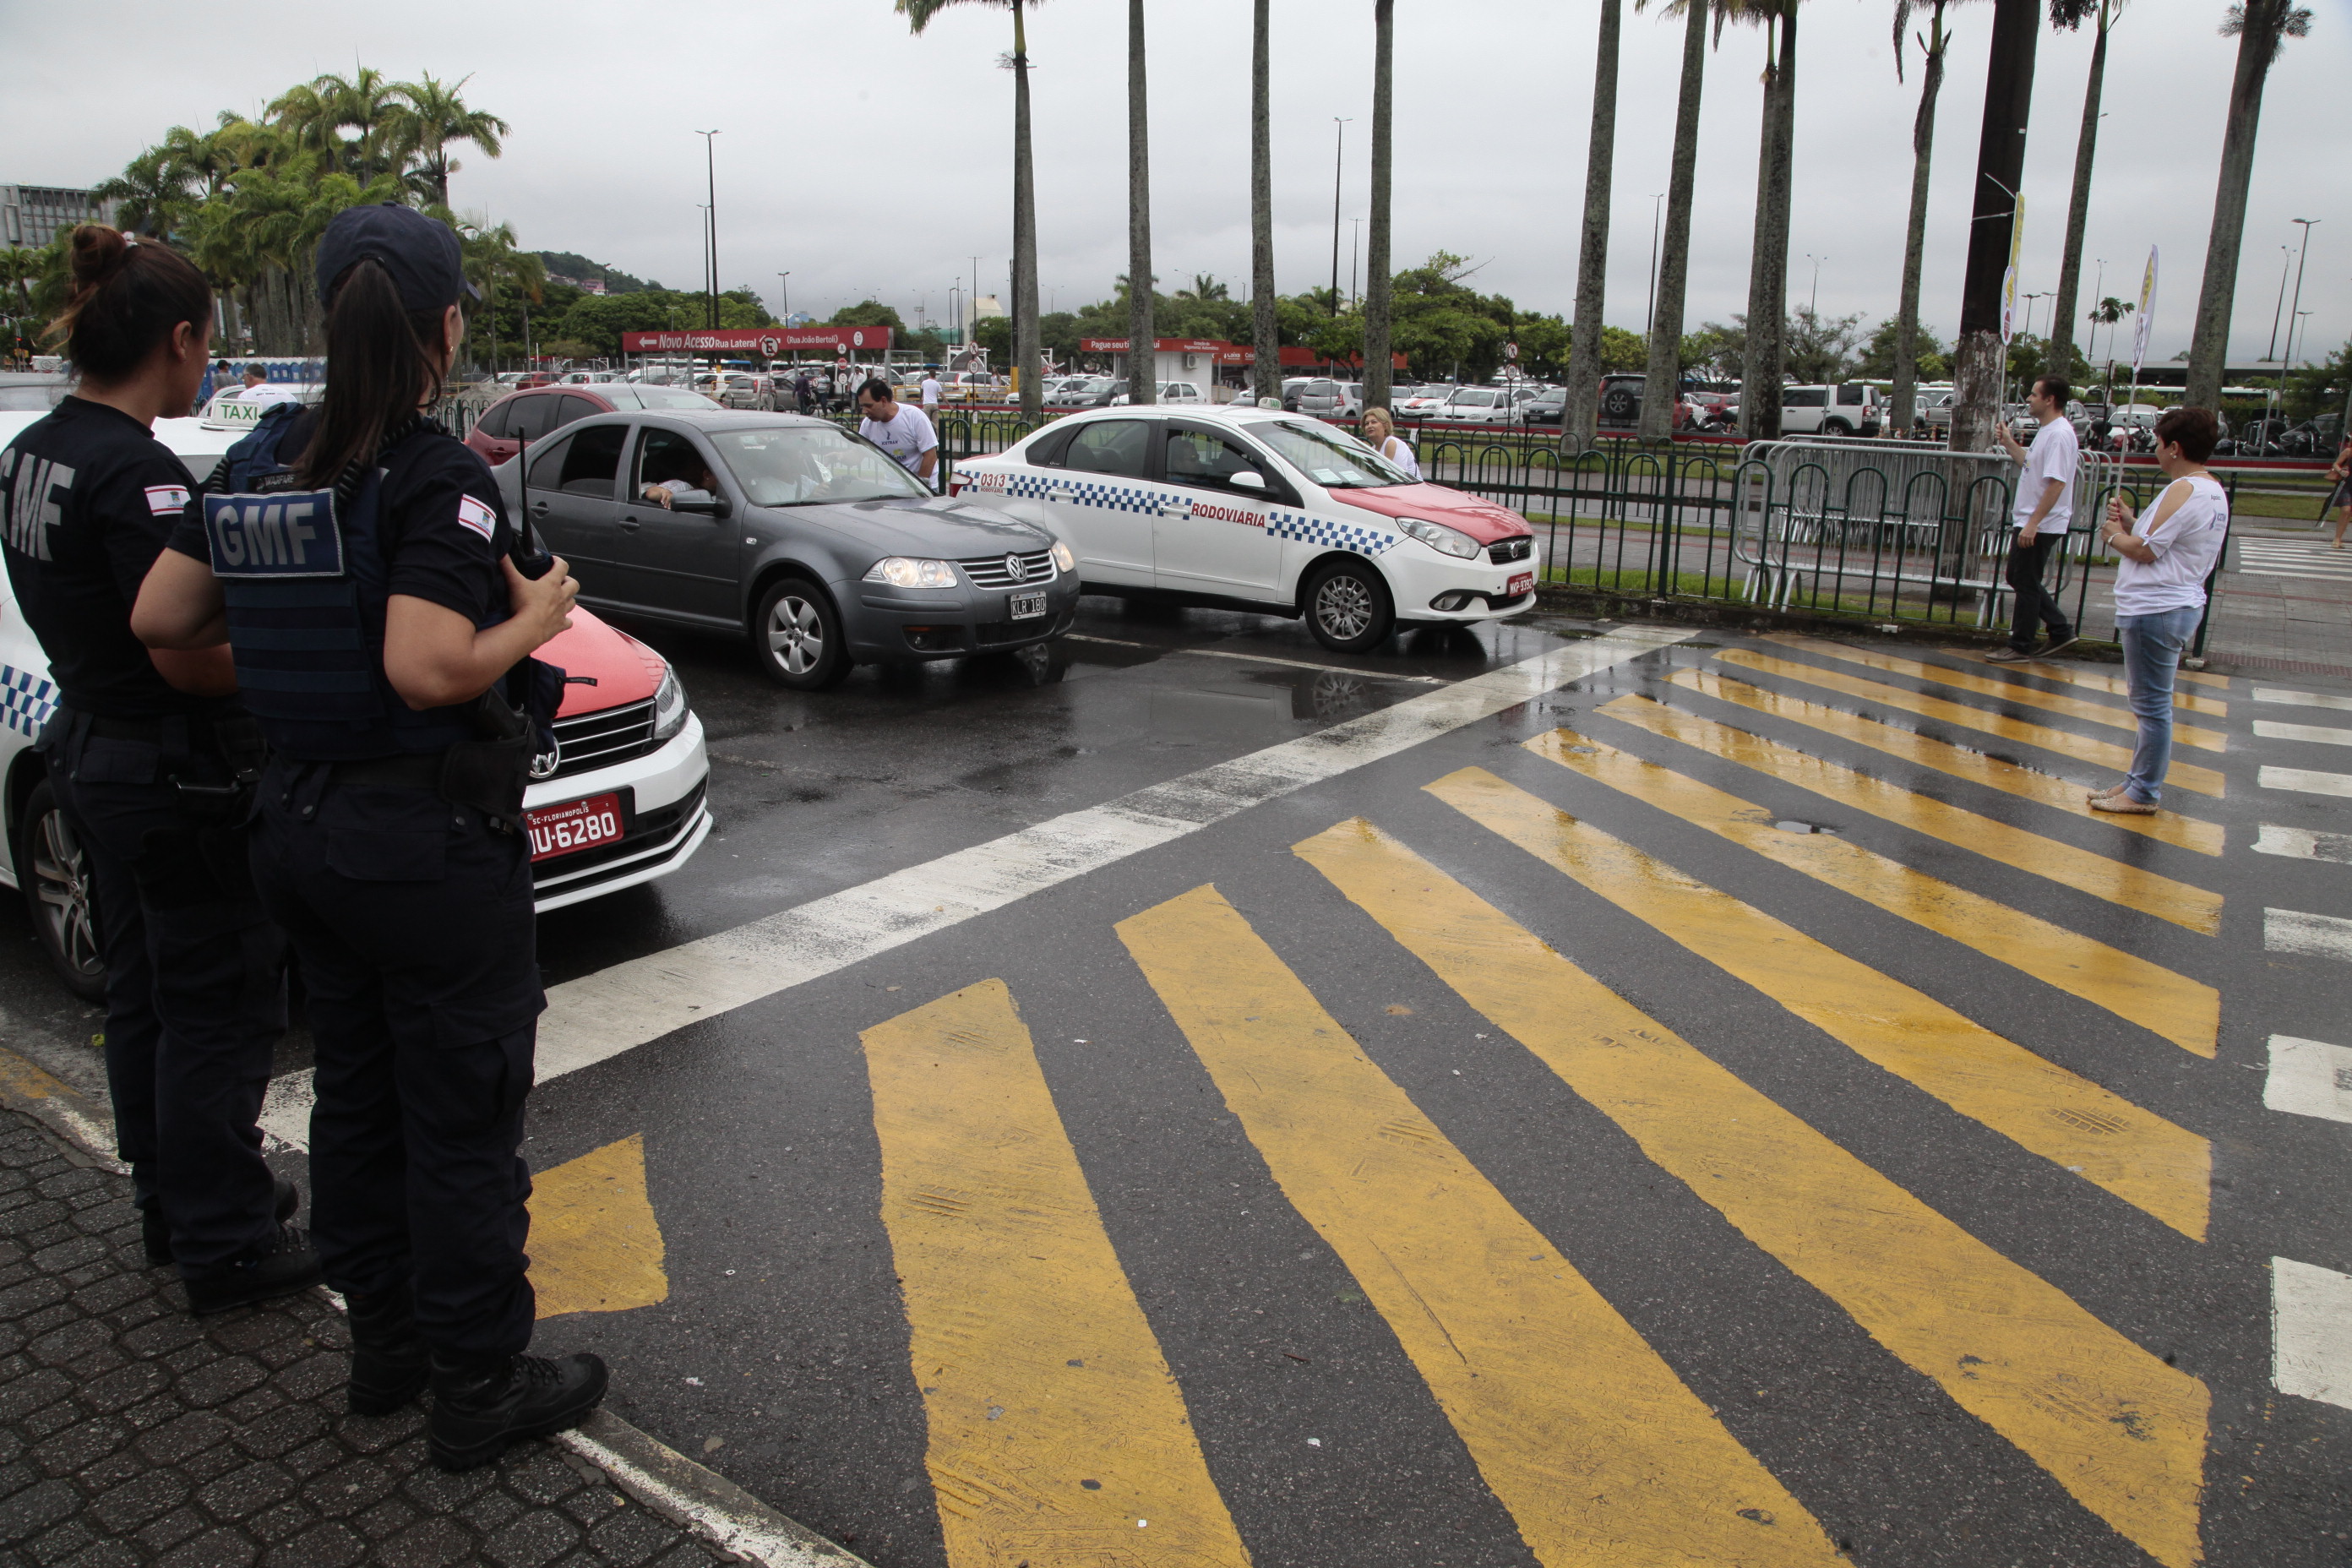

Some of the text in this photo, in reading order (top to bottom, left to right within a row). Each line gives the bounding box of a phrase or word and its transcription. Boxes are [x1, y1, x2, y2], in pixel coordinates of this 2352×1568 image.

[659, 334, 757, 349] Novo Acesso Rua Lateral
[787, 334, 838, 345] (Rua João Bertoli)
[1091, 340, 1112, 351] Pague
[220, 404, 259, 421] TAXI
[264, 474, 295, 487] WARFARE
[980, 473, 1006, 487] 0313
[215, 502, 317, 567] GMF
[1012, 597, 1045, 615] KLR 180
